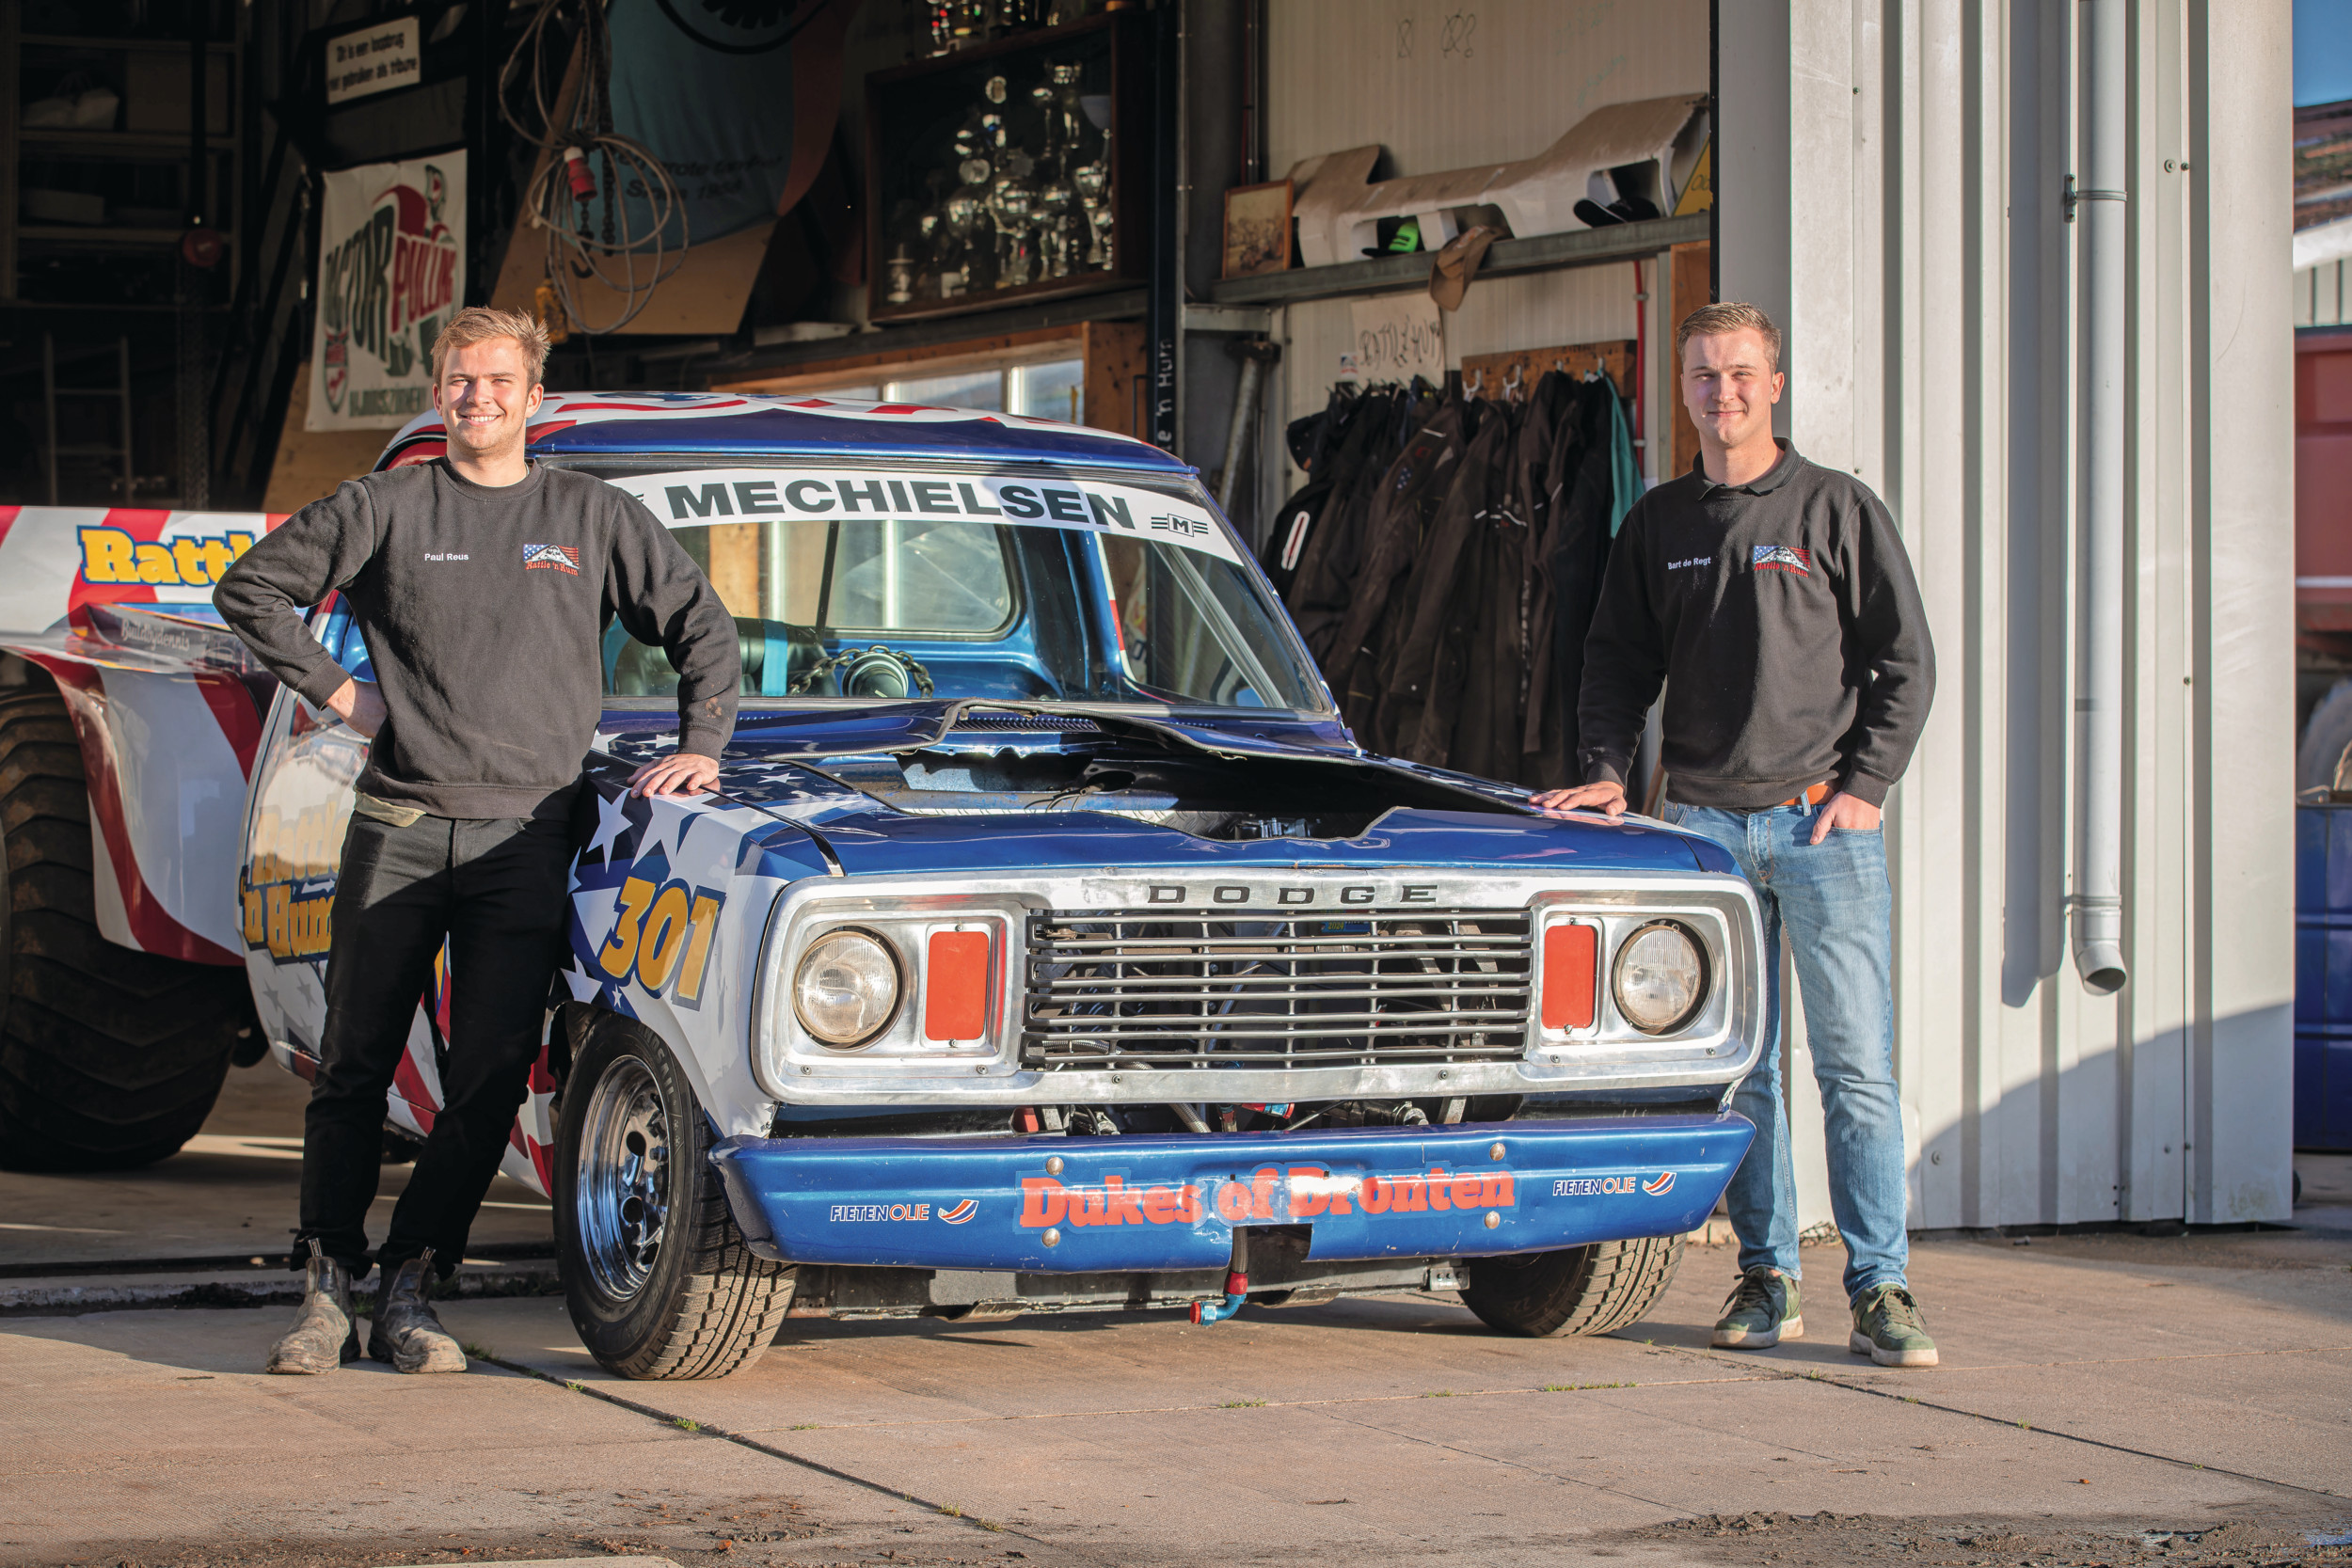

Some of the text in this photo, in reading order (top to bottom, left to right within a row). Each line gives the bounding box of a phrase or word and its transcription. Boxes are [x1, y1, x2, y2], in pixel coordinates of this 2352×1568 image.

[664, 480, 1136, 530] MECHIELSEN
[424, 553, 469, 562] Paul Reus
[1667, 560, 1682, 570] Bart
[1693, 557, 1711, 566] Regt
[525, 560, 551, 570] Rattle
[560, 562, 580, 577] Hum
[1148, 884, 1438, 904] DODGE
[599, 876, 720, 1002] 301
[1020, 1166, 1516, 1227] Dukes of Dronten
